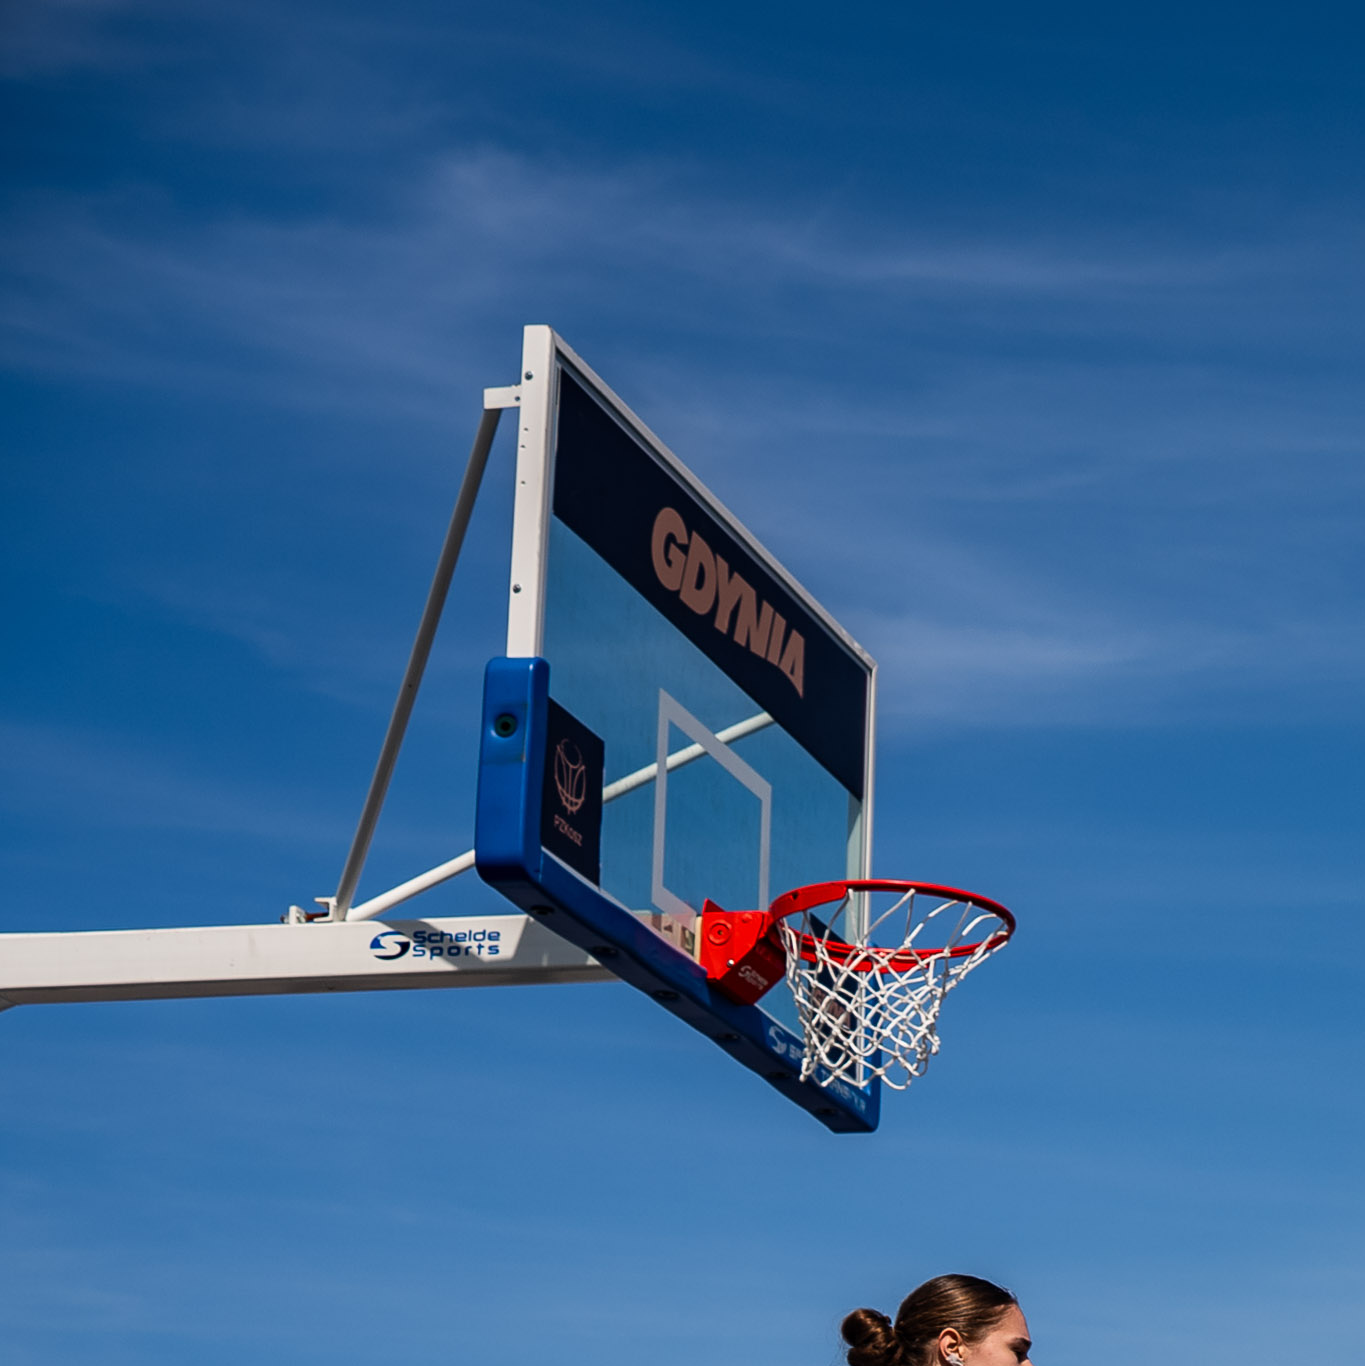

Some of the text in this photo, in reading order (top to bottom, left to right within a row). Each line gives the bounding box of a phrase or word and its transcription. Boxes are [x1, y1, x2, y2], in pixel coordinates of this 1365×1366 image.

[652, 507, 804, 699] GDYNIA
[412, 930, 501, 944] Schelde
[412, 943, 500, 960] Sports
